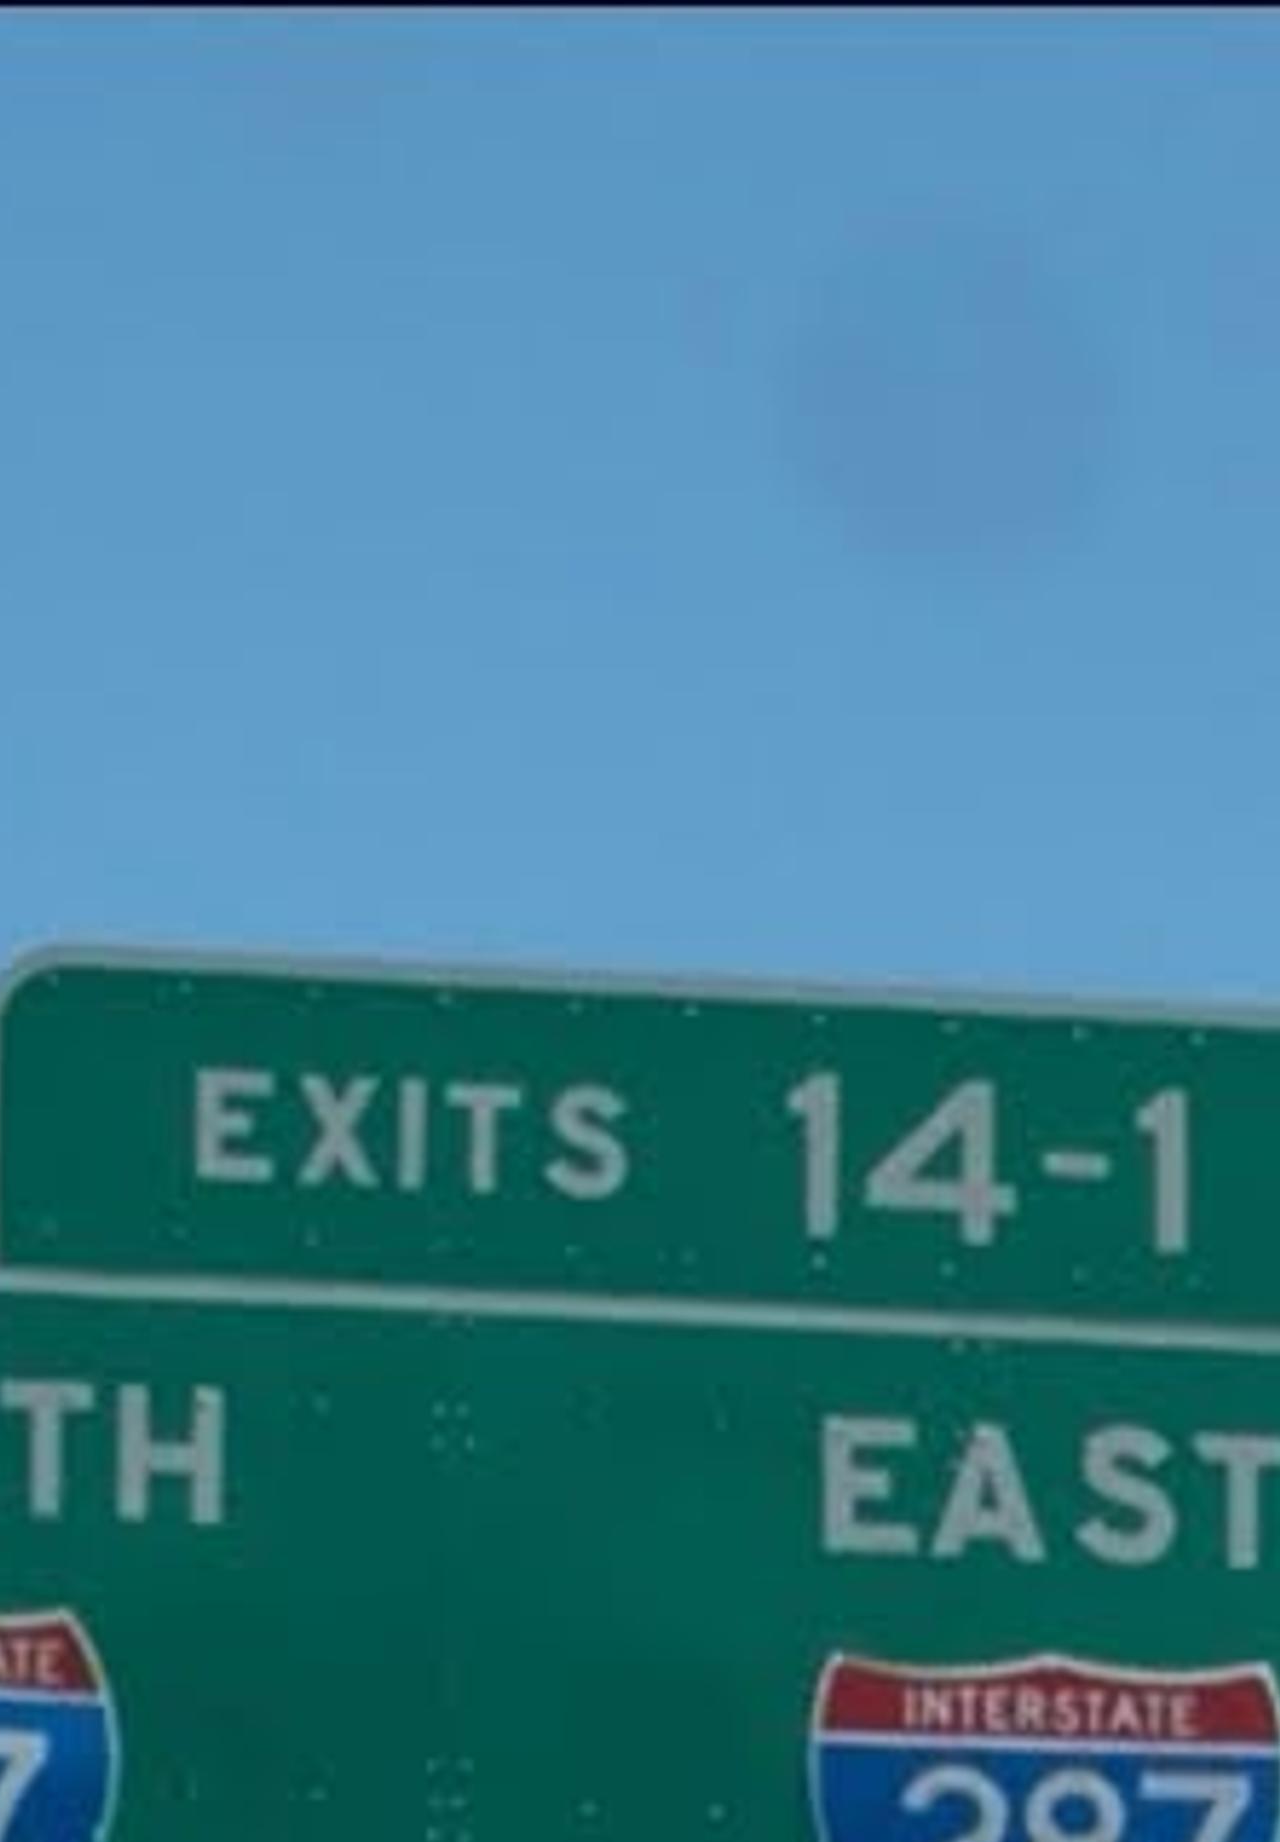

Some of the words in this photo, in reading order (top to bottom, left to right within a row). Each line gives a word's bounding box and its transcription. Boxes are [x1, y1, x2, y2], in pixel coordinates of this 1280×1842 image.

[190, 1066, 631, 1201] EXITS
[786, 1072, 1194, 1256] 14-1
[902, 1684, 1202, 1736] INTERSTATE
